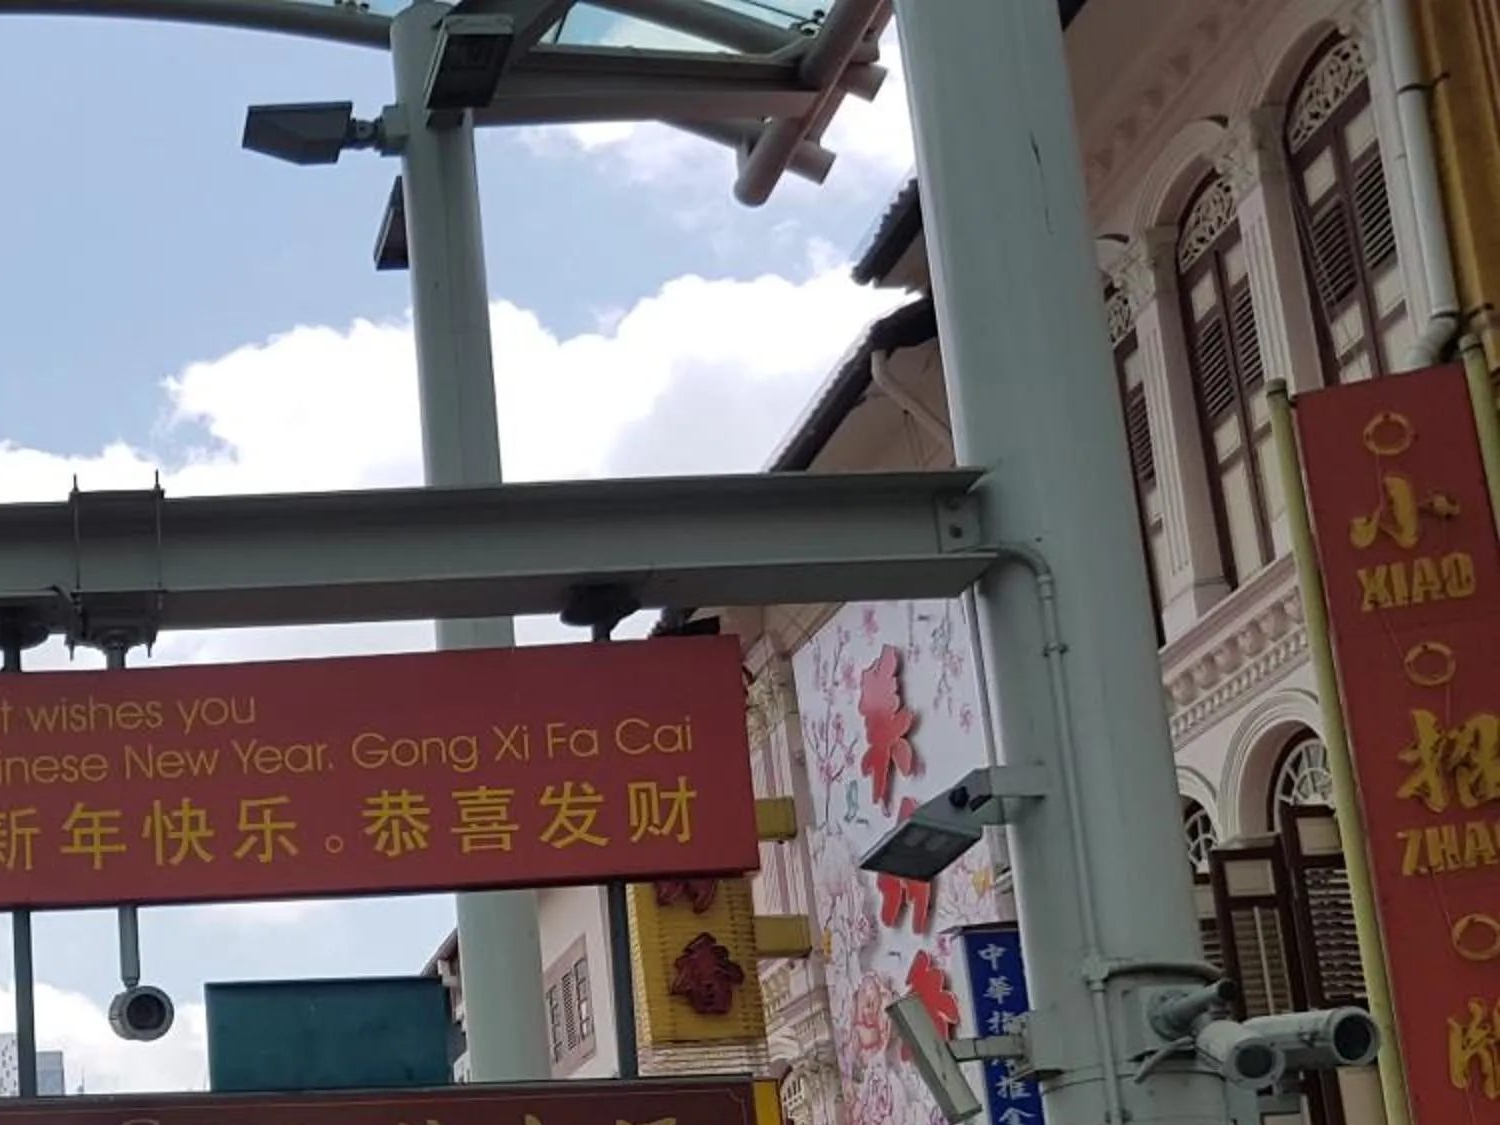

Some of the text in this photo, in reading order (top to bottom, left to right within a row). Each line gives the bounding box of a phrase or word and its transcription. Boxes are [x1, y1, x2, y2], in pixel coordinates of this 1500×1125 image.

[1356, 552, 1477, 612] XIAO
[26, 693, 164, 734] wishes
[175, 695, 257, 738] you
[124, 742, 218, 780] New
[231, 738, 335, 777] Year.
[351, 730, 479, 773] Gong
[494, 723, 531, 761] Xi
[547, 720, 599, 760] Fa
[614, 714, 694, 755] Cai
[1396, 820, 1500, 877] ZHA
